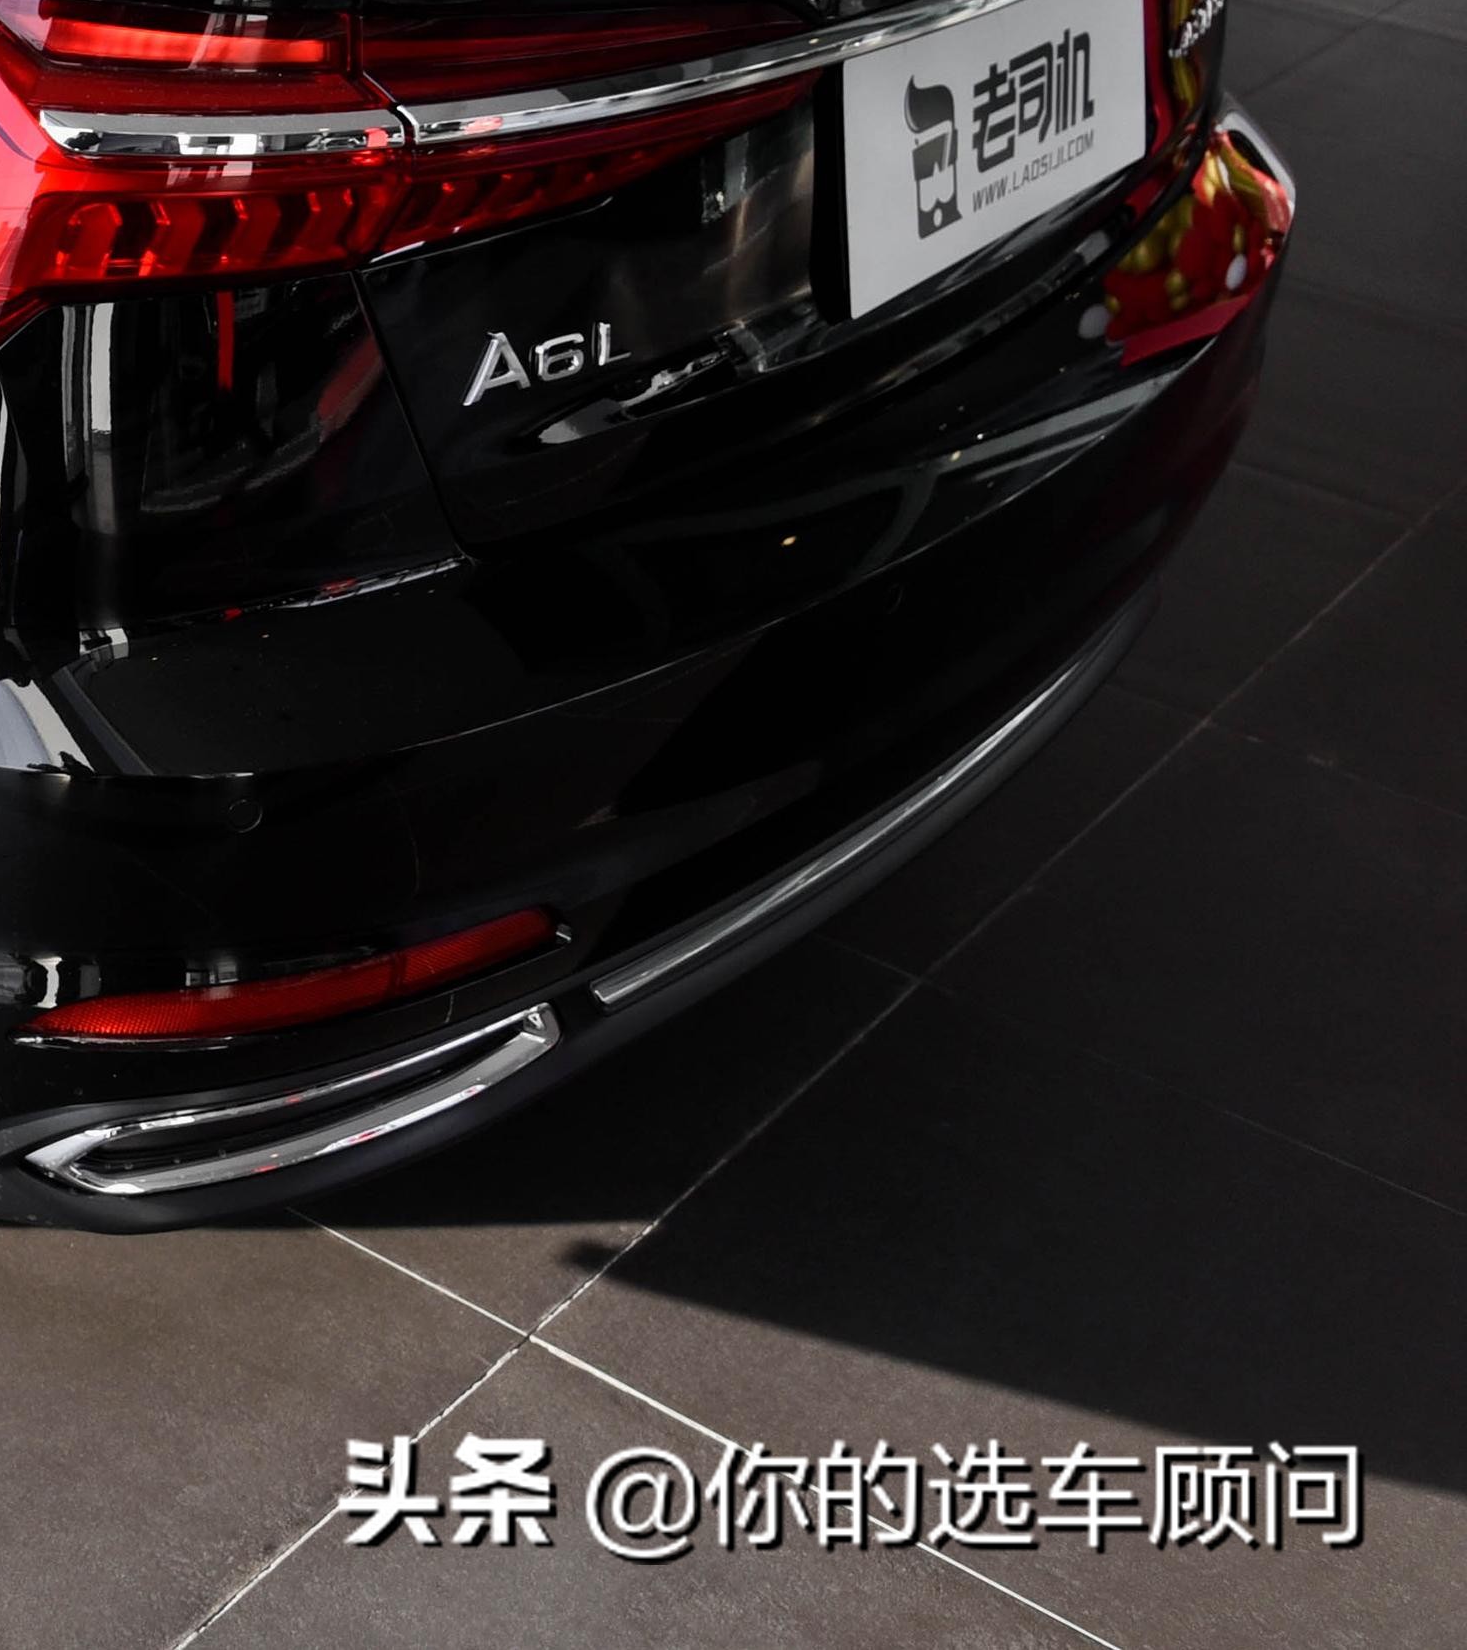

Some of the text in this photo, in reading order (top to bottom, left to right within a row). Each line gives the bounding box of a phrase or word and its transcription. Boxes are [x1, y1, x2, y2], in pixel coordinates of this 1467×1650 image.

[973, 28, 1094, 173] 老司机
[972, 128, 1095, 213] WWW.LAOSIJI.COM
[463, 321, 632, 406] A6L
